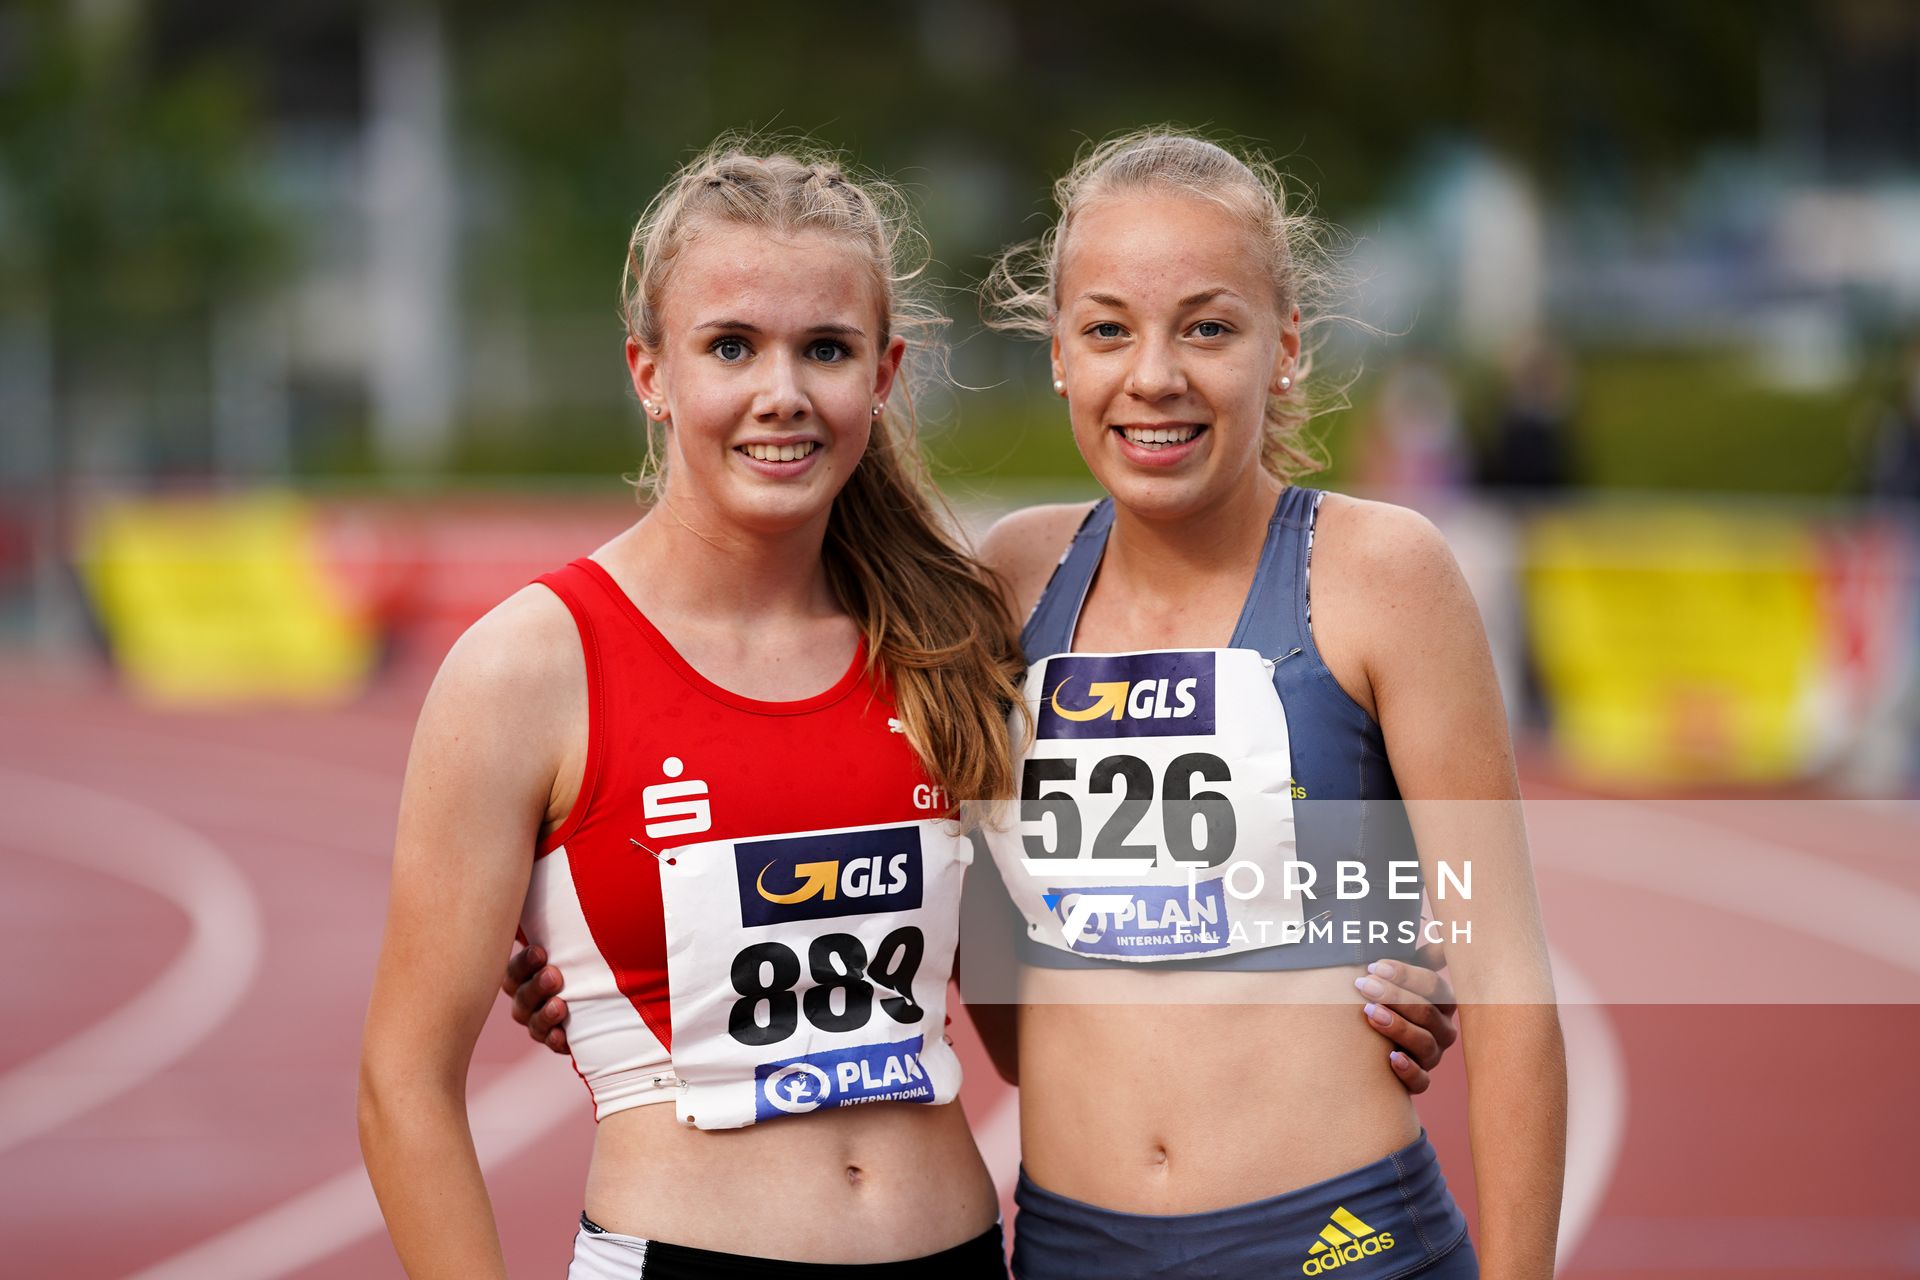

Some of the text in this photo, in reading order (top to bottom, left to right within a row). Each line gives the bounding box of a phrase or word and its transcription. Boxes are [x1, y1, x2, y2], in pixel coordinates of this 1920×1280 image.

[1128, 677, 1196, 718] GLS
[1019, 752, 1237, 869] 526
[841, 853, 907, 898] GLS
[1114, 895, 1218, 930] PLAN
[729, 926, 924, 1046] 889
[836, 1053, 923, 1092] PLAN
[1302, 1231, 1395, 1276] adidas
